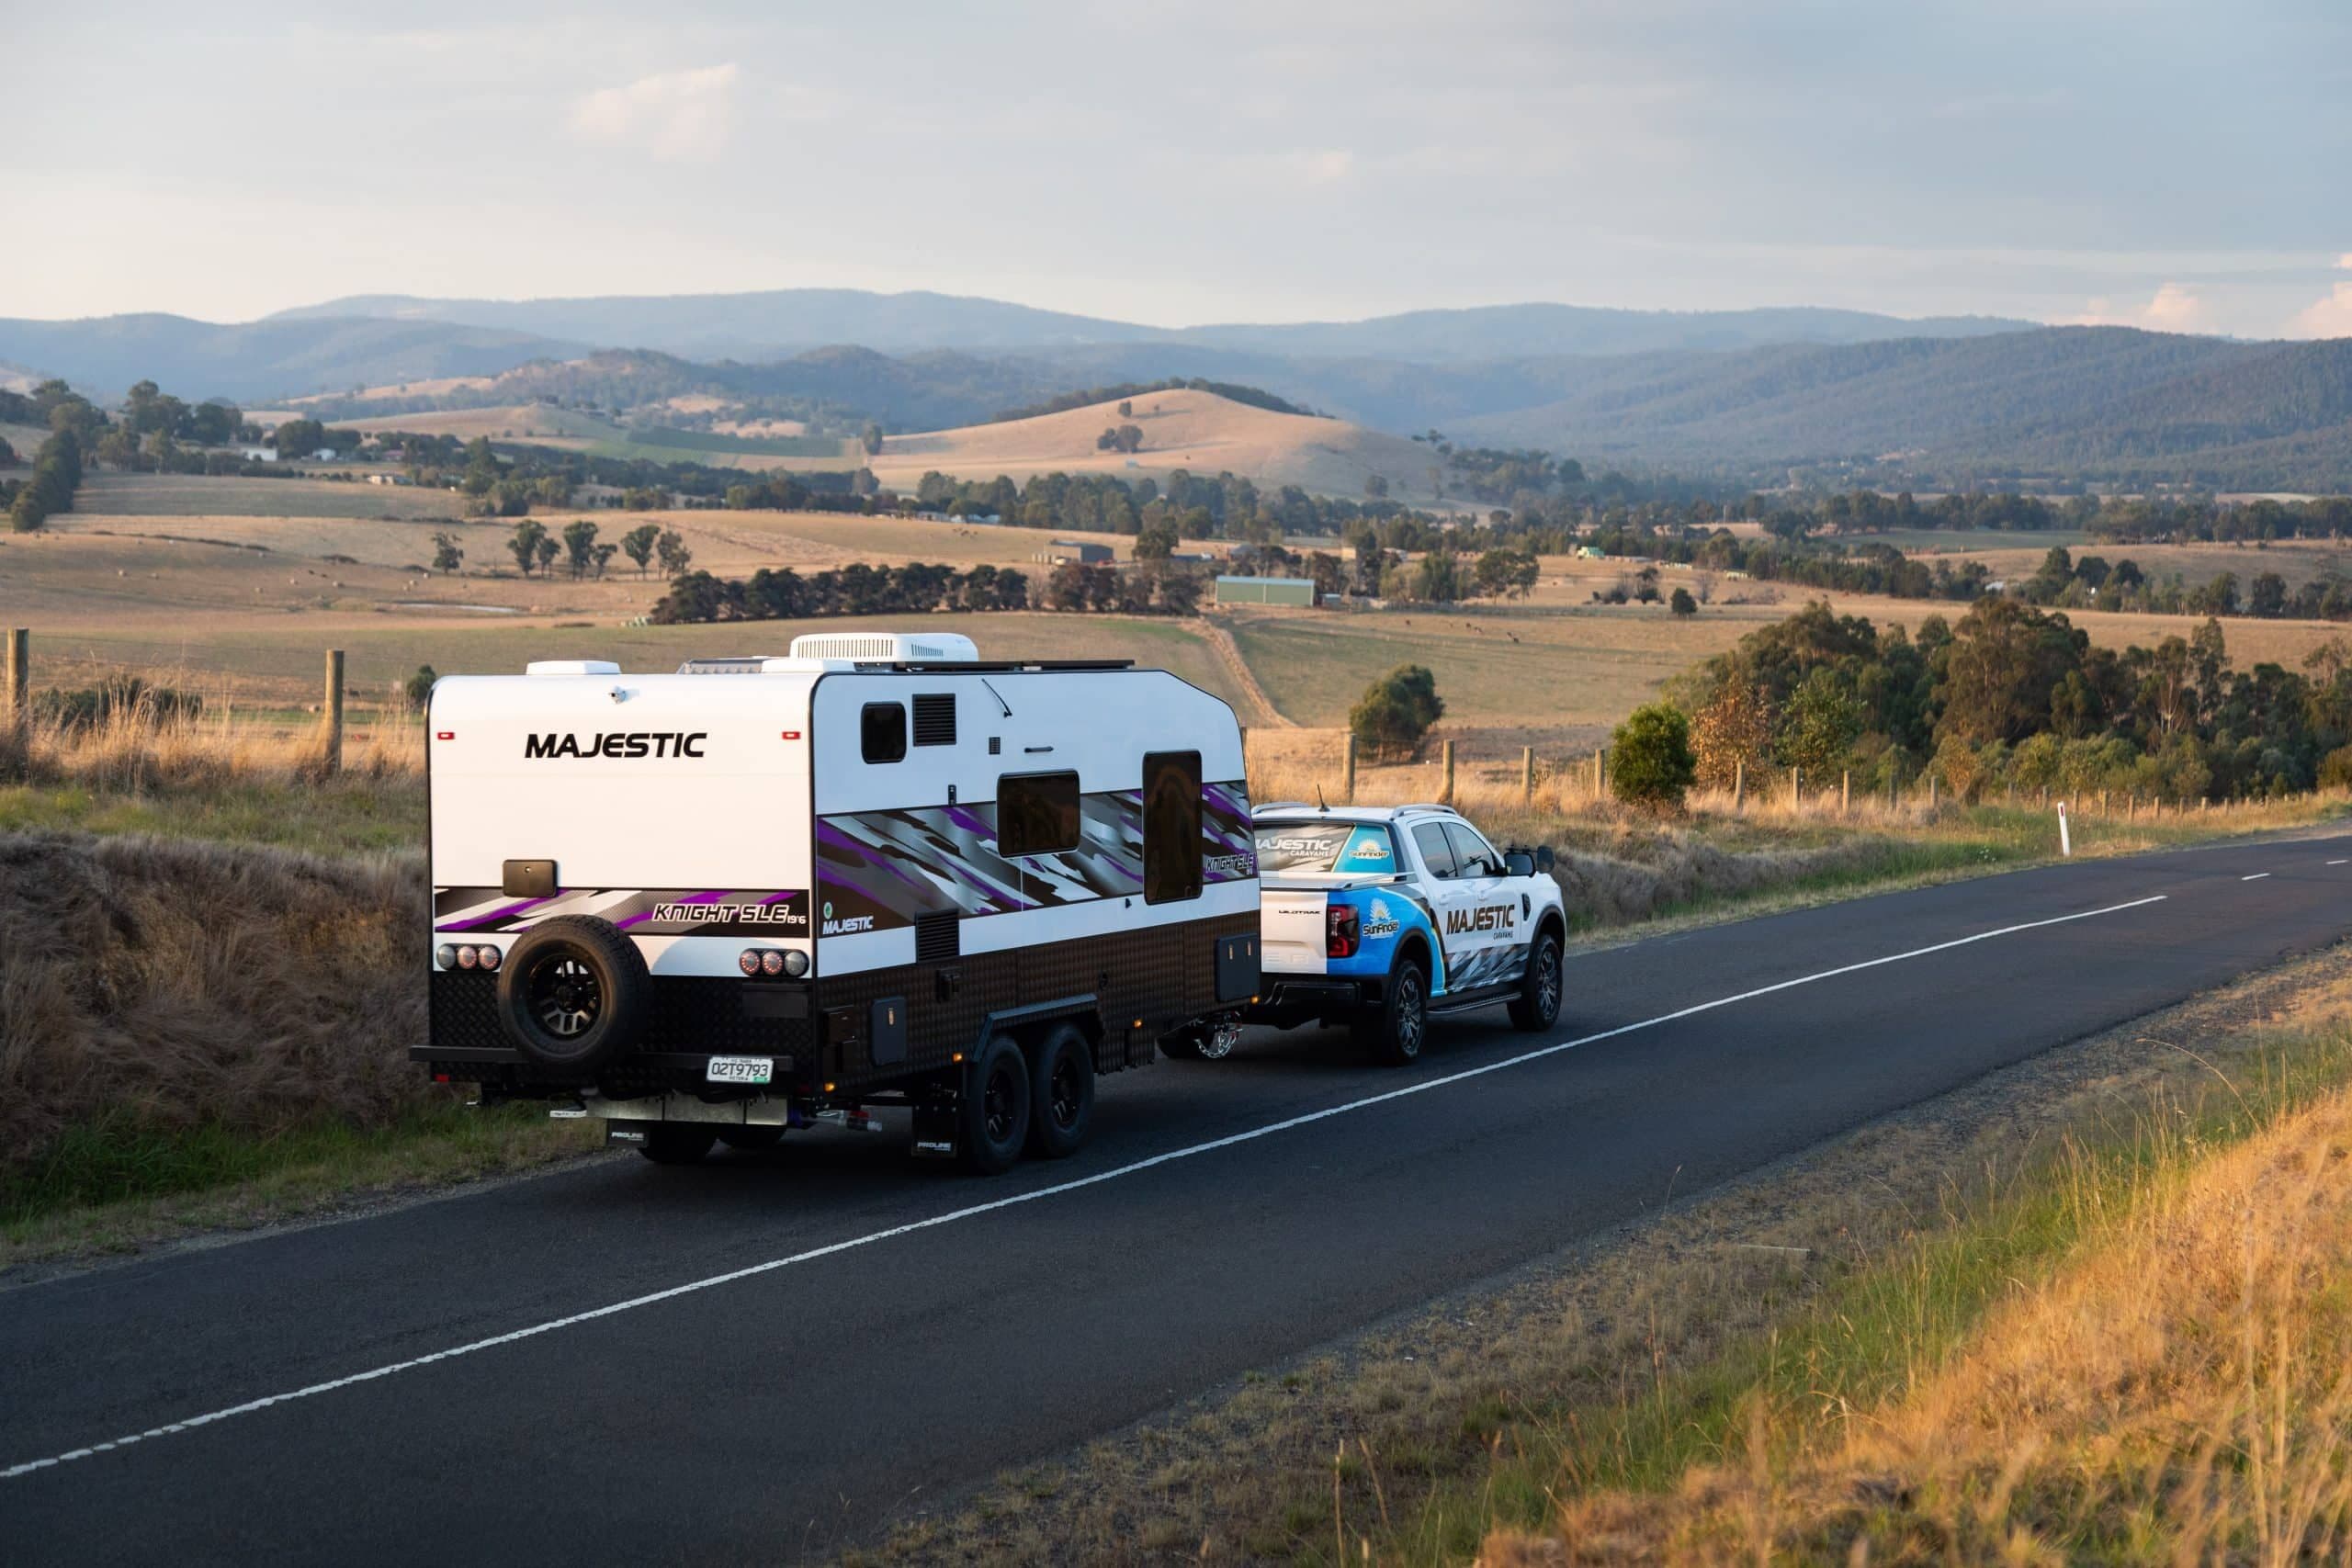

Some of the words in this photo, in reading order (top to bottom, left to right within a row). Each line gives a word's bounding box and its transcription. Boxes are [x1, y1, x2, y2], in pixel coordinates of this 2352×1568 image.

[525, 732, 707, 759] MAJESTIC
[1205, 854, 1238, 873] KNIGHT
[651, 903, 737, 923] KNIGHT
[739, 904, 789, 924] SLE
[1446, 905, 1515, 935] MAJESTIC
[822, 915, 875, 935] MAJESTIC
